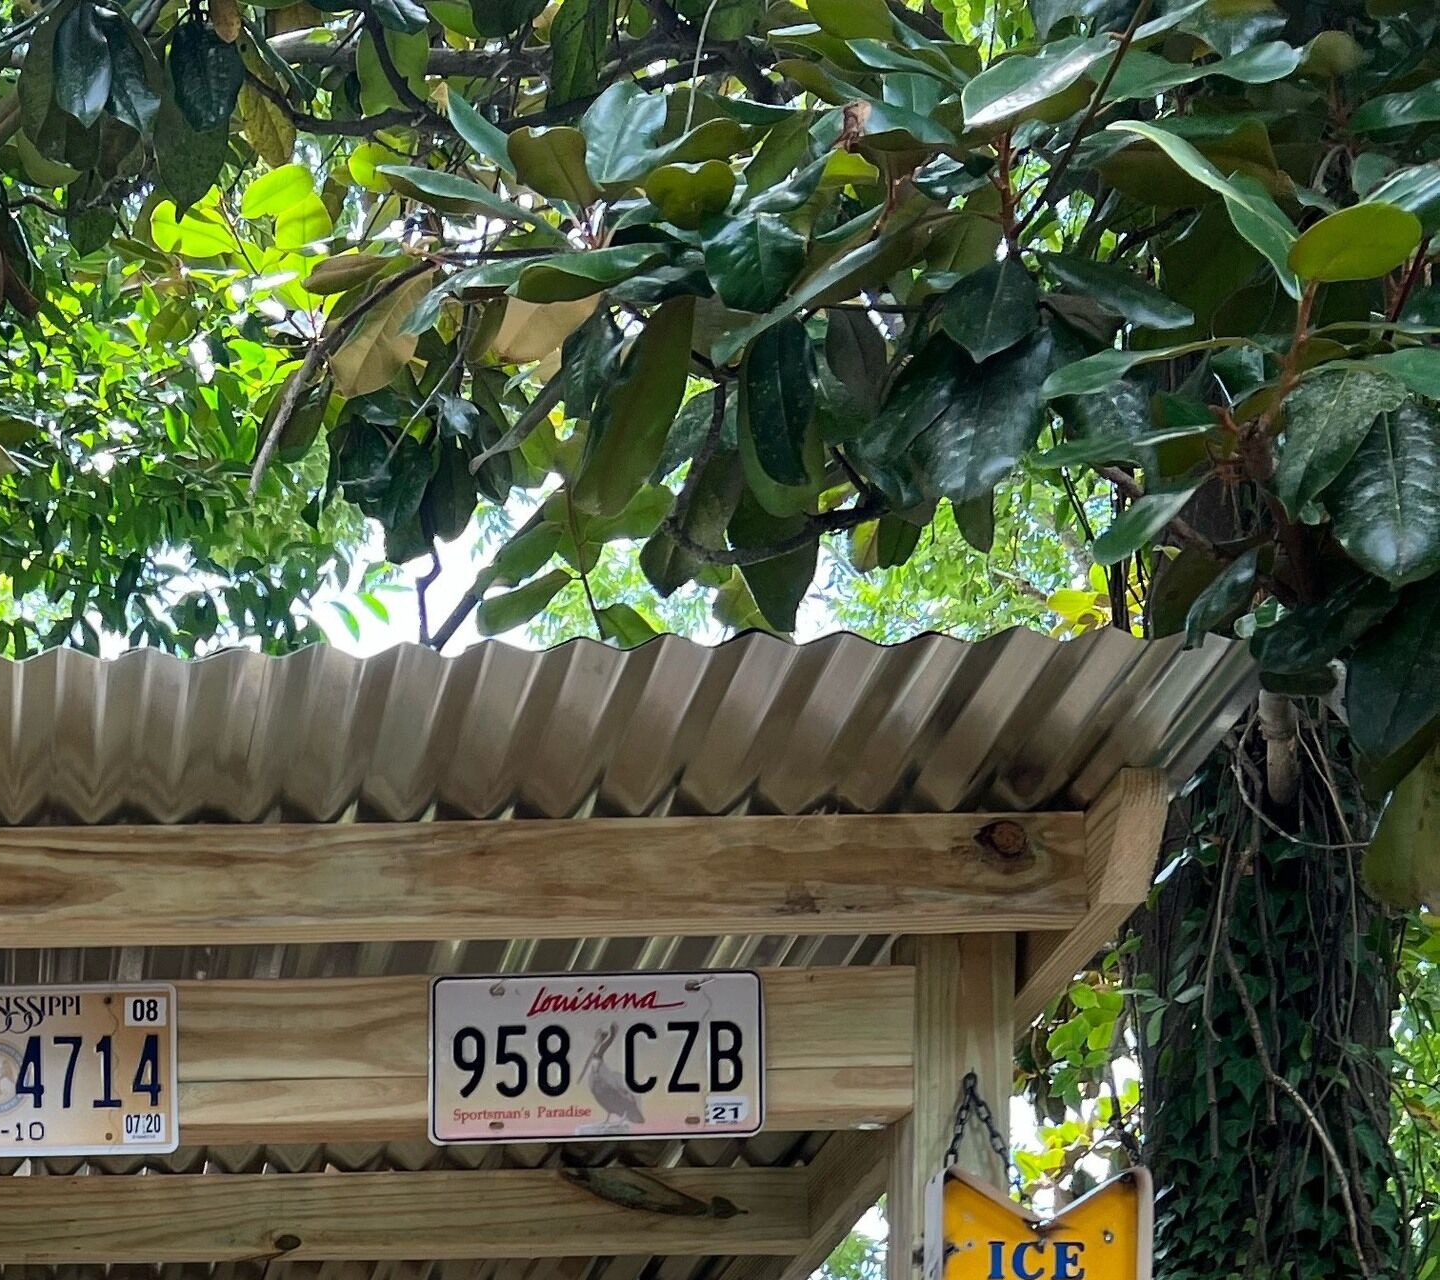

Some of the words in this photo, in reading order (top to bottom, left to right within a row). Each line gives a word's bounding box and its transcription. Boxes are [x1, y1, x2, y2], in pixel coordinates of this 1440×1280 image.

[132, 999, 159, 1022] 08
[526, 984, 685, 1017] Louisiana
[452, 1024, 571, 1099] 958
[624, 1020, 743, 1094] CZB
[15, 1034, 162, 1109] 4714
[125, 1114, 141, 1134] 07
[145, 1113, 161, 1133] 20
[452, 1106, 530, 1122] Sportsman's
[537, 1105, 592, 1119] Paradise
[712, 1106, 739, 1119] 21
